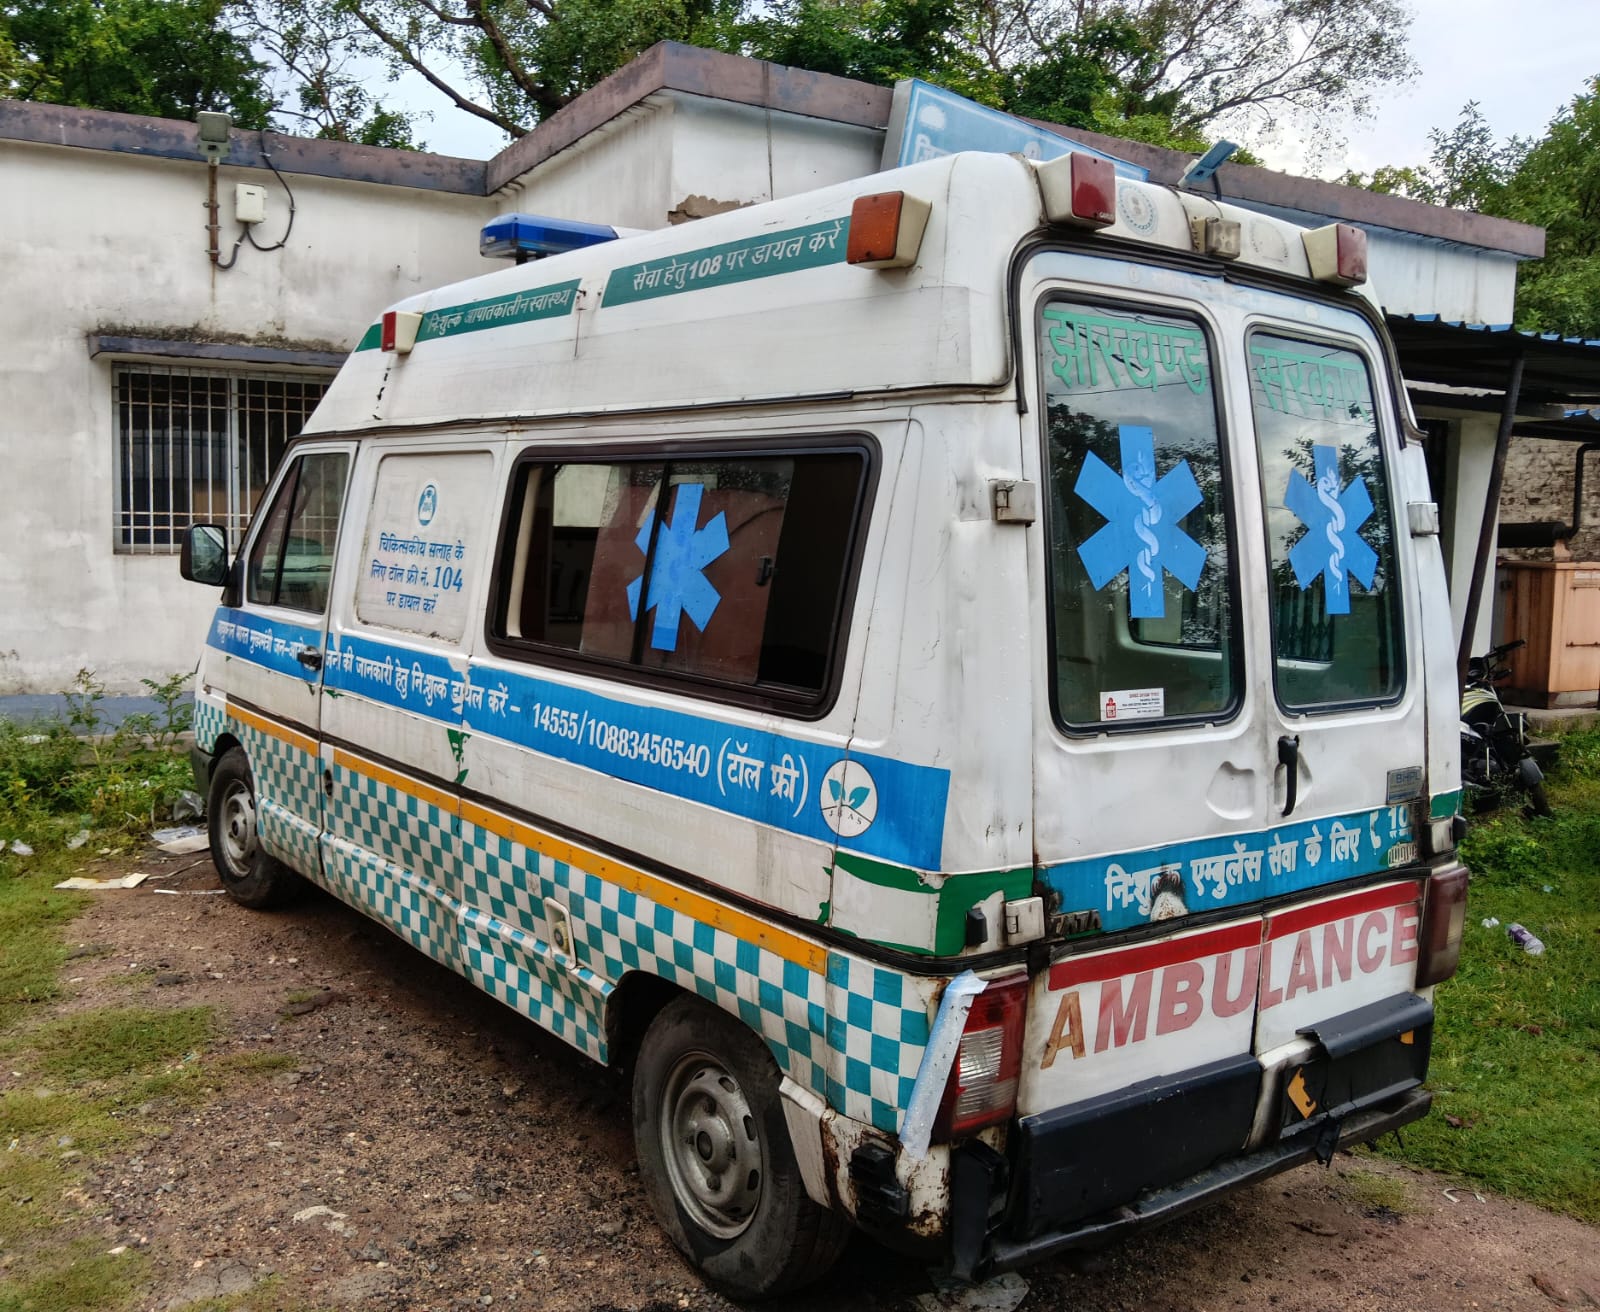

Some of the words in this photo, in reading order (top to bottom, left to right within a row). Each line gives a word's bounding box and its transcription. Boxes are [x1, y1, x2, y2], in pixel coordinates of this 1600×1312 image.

[633, 265, 663, 290] सेवा
[664, 259, 690, 289] हेतु
[689, 254, 723, 280] 108
[726, 248, 750, 270] पर
[751, 236, 806, 264] डायल
[808, 220, 844, 252] करें
[1250, 345, 1368, 422] सरकार
[371, 560, 387, 582] लिए
[433, 566, 463, 592] 104
[455, 540, 466, 561] के
[386, 591, 397, 608] पर
[398, 593, 421, 612] डायल
[355, 655, 393, 686] जानकारी
[395, 659, 409, 699] हेतु
[533, 702, 711, 777] 14555/10883456540
[717, 737, 765, 797] (टॉल
[770, 753, 809, 818] फ्री)
[1190, 840, 1264, 899] एम्बुलेंस
[1268, 833, 1298, 876] सेवा
[1304, 824, 1323, 867] के
[1329, 821, 1361, 863] लिए
[1041, 902, 1419, 1070] AMBULANCE
